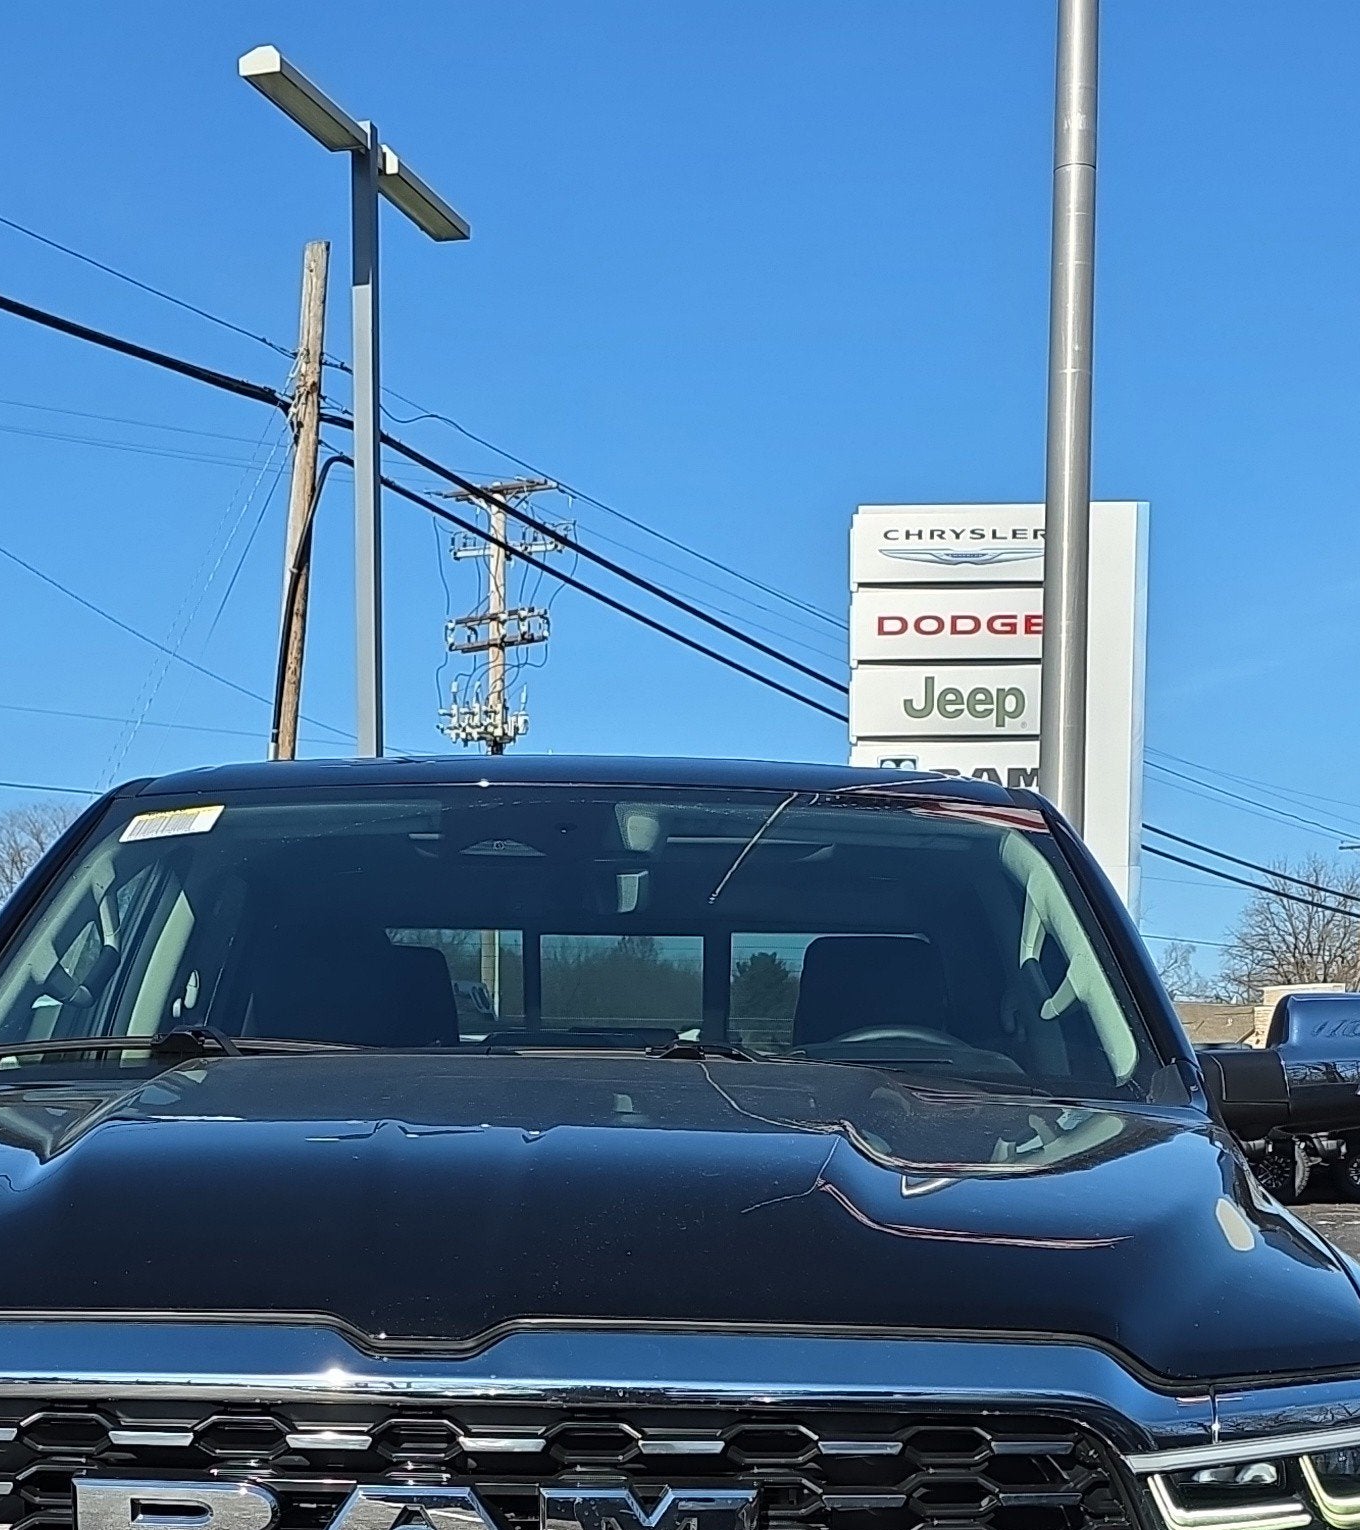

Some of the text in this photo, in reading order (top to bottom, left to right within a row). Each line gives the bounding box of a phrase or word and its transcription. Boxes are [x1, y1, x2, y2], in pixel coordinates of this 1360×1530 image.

[883, 528, 1044, 540] CHRYSLER
[877, 614, 1043, 636] DODGE
[903, 676, 1026, 728] Jeep
